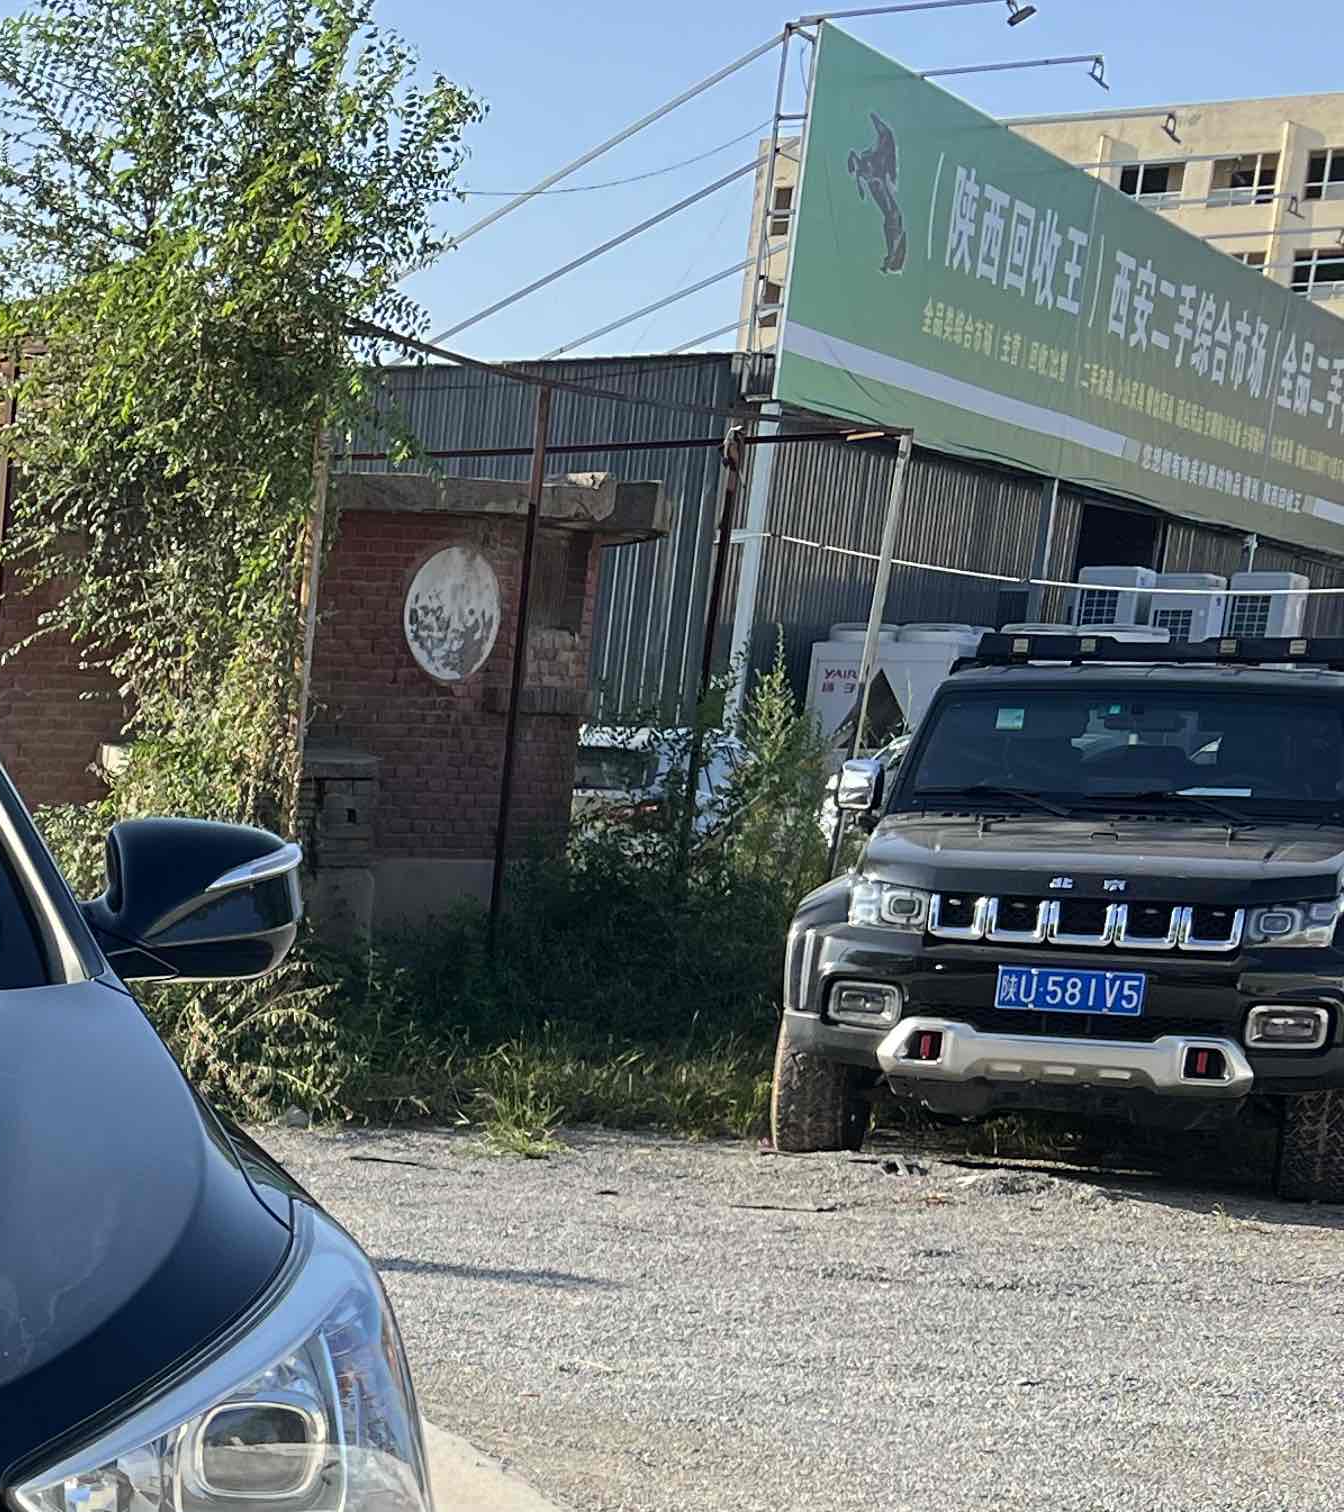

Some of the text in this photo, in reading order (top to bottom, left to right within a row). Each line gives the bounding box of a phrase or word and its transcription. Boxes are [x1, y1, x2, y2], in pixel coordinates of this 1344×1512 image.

[945, 165, 1088, 314] 陕西回收王
[1108, 249, 1269, 399] 西安二手综合市场
[1277, 332, 1344, 436] 全品二手
